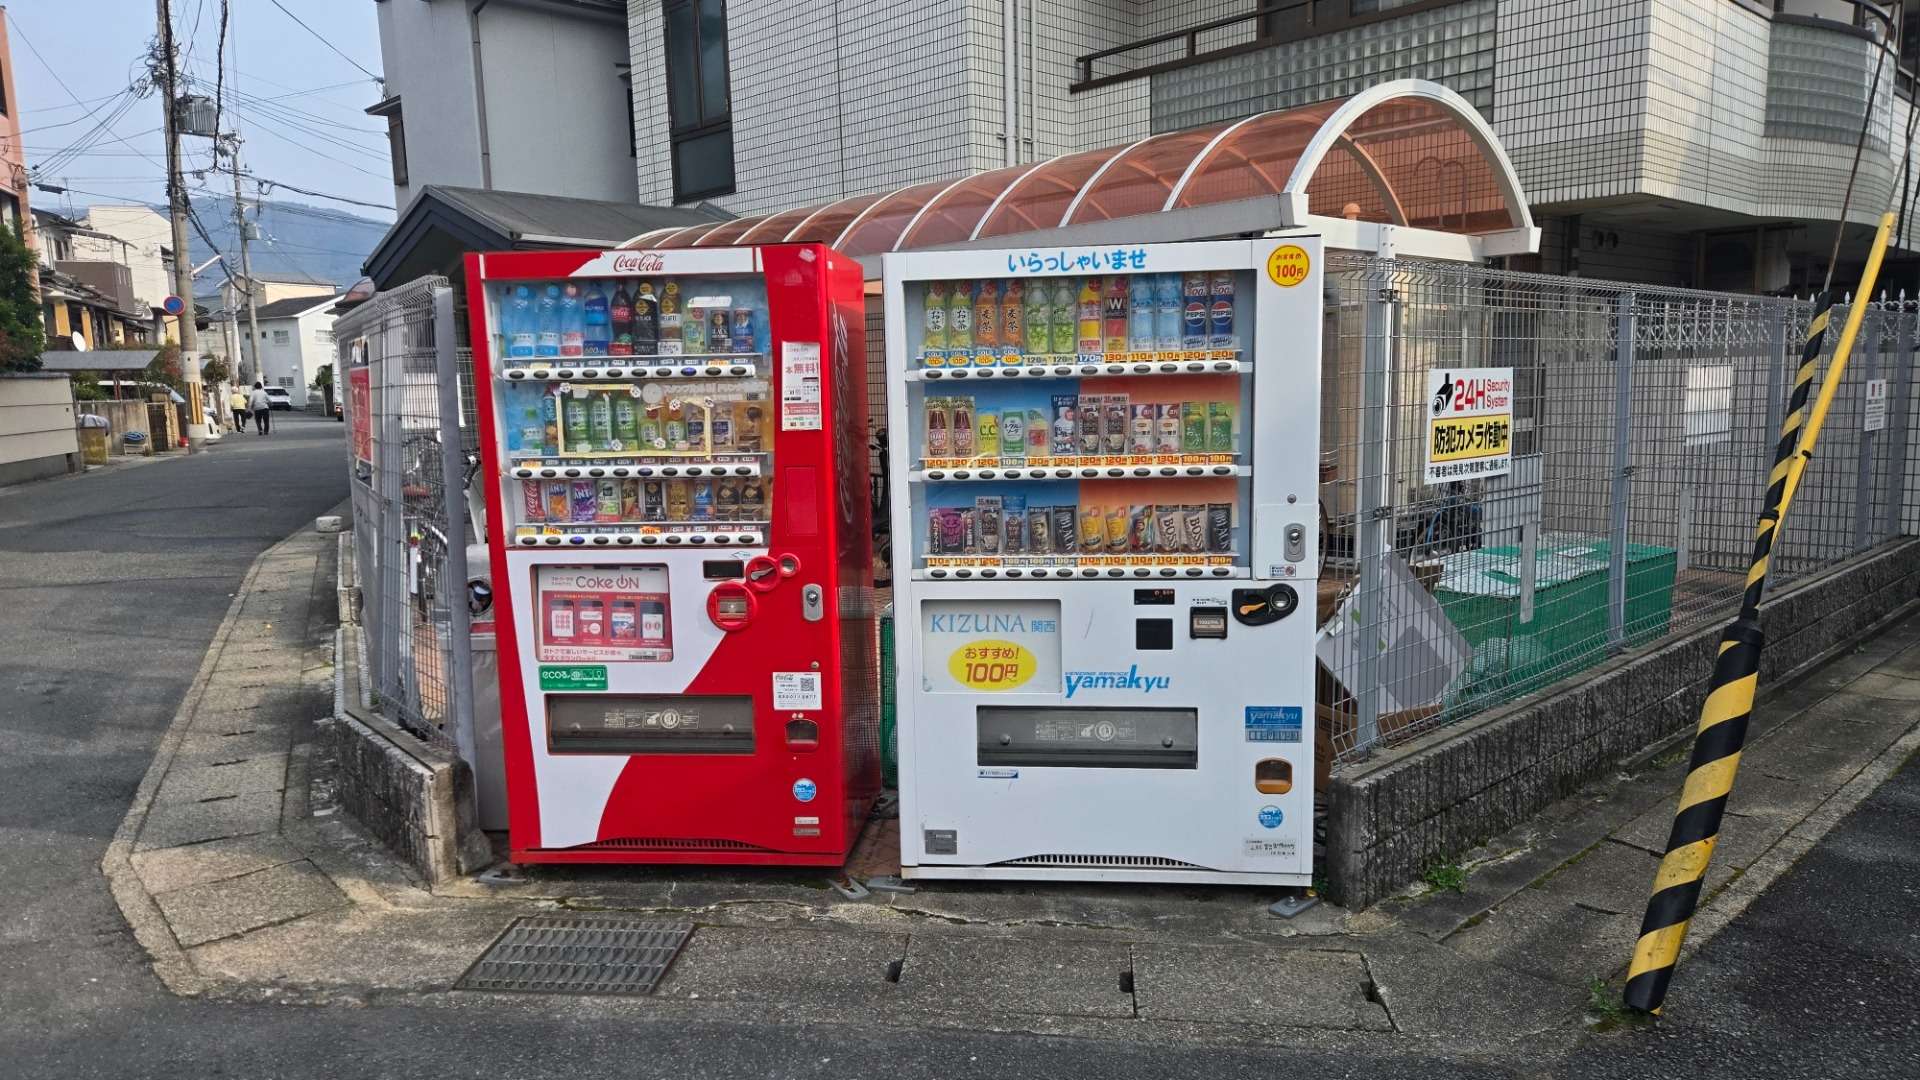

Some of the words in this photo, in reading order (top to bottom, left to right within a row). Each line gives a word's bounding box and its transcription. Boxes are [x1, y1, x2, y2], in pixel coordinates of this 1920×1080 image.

[613, 253, 665, 272] Coca-Cola
[1008, 249, 1146, 272] いらっしゃいませ
[1109, 298, 1122, 309] W
[931, 310, 941, 330] お茶
[957, 310, 967, 330] お茶
[1007, 308, 1018, 333] 麦茶
[1212, 310, 1231, 318] PEPSI
[1079, 354, 1101, 362] 170円
[1131, 352, 1153, 360] 110円
[1183, 351, 1206, 359] 120円
[1454, 378, 1486, 411] 24H
[1486, 379, 1510, 393] Security
[1486, 395, 1508, 409] System
[1433, 421, 1508, 455] 防犯カメラ作動中
[1163, 519, 1177, 549] BOSS
[1189, 518, 1203, 549] BOSS
[1157, 556, 1178, 564] 110円
[575, 575, 613, 589] Coke
[616, 574, 640, 589] ON
[931, 614, 1026, 633] KIZUNA
[1031, 620, 1056, 633] 関西
[965, 647, 1020, 659] おすすめ!
[966, 663, 1019, 683] 100円
[1065, 664, 1170, 698] yamakyu
[1250, 708, 1298, 724] yamakyu
